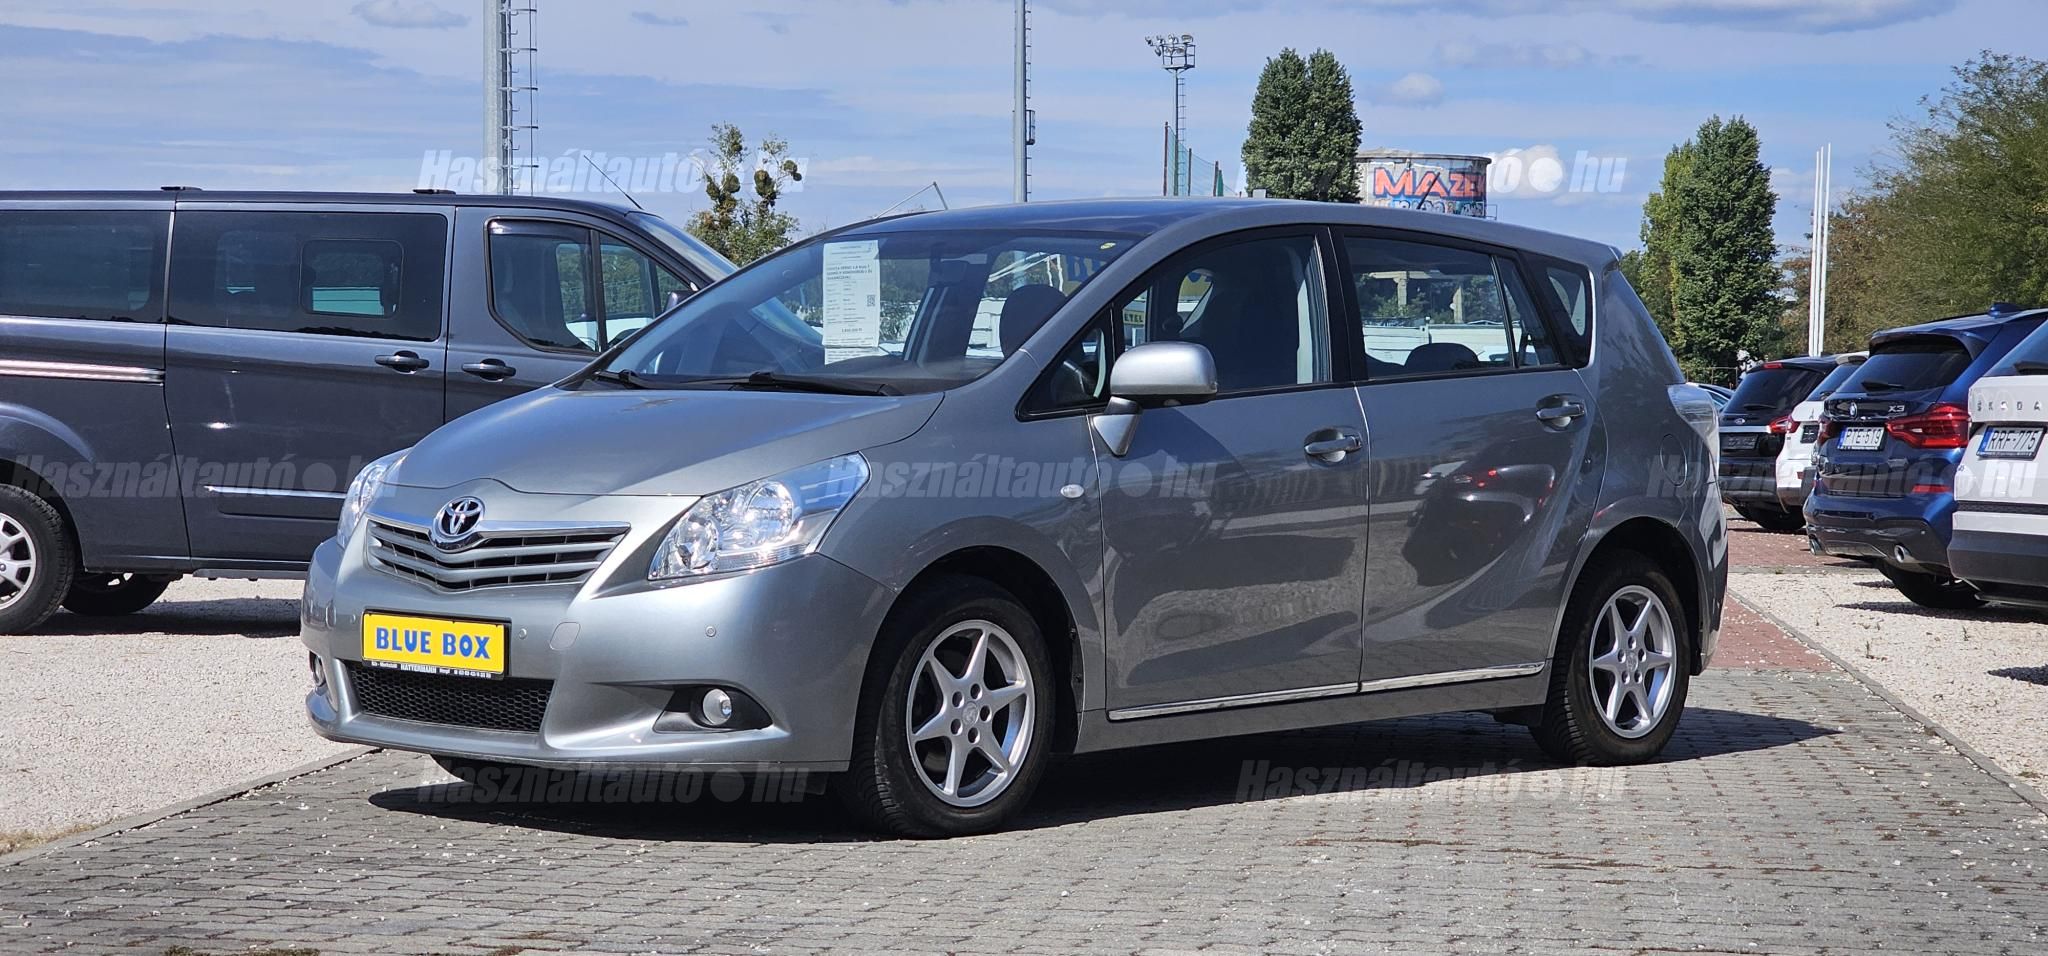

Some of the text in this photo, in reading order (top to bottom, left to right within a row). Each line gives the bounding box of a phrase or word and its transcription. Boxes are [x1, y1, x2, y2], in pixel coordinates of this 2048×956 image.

[1888, 404, 1905, 412] X3
[1988, 430, 2038, 451] RRF-775
[376, 626, 491, 660] BLUE BOX
